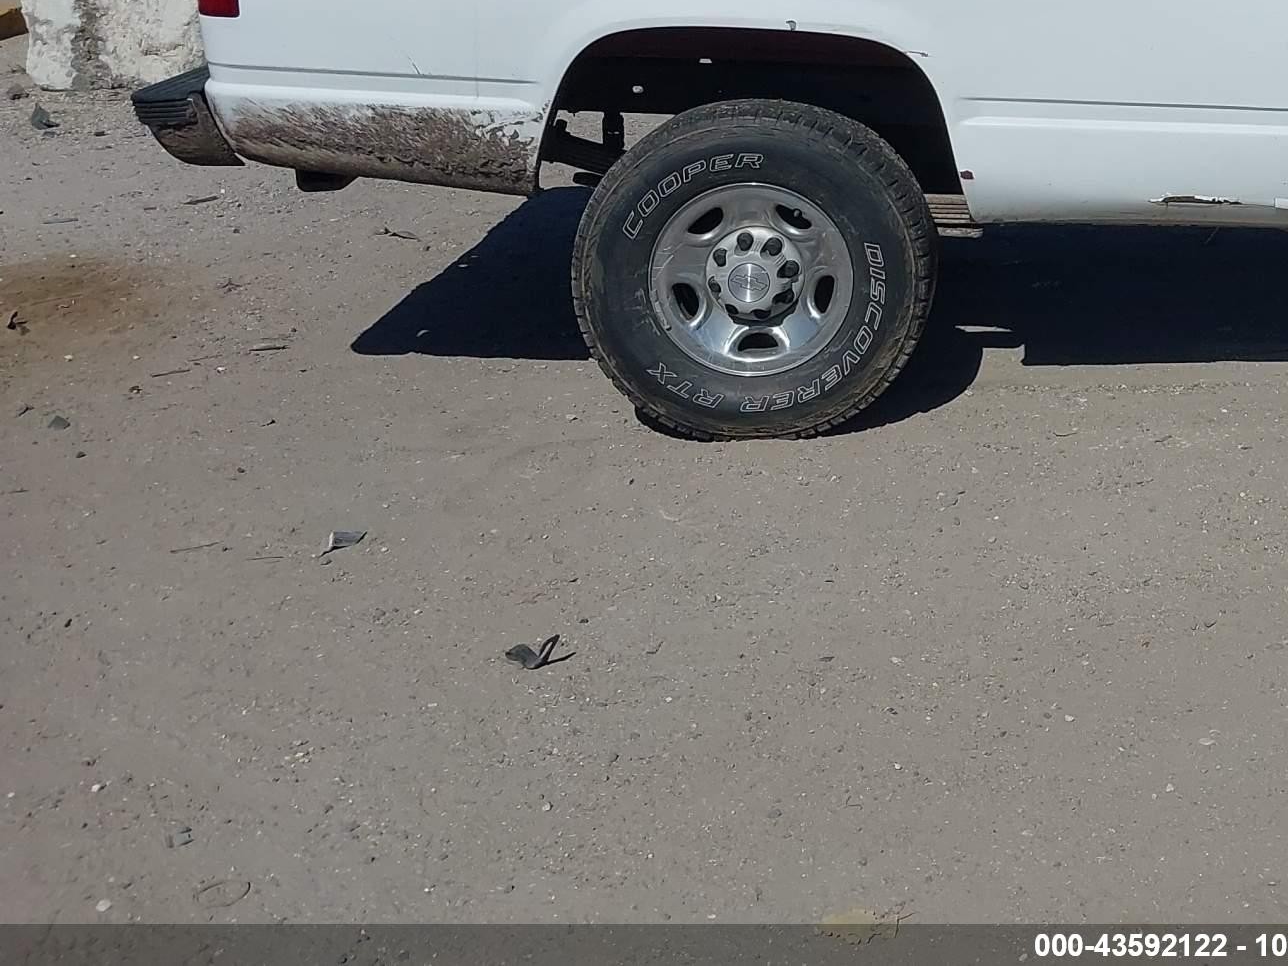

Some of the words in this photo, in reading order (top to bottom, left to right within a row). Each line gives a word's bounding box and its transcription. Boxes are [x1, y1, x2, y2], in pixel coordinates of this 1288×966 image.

[622, 152, 765, 241] COOPER
[739, 242, 887, 413] DISCOVERER
[647, 361, 724, 409] RTX
